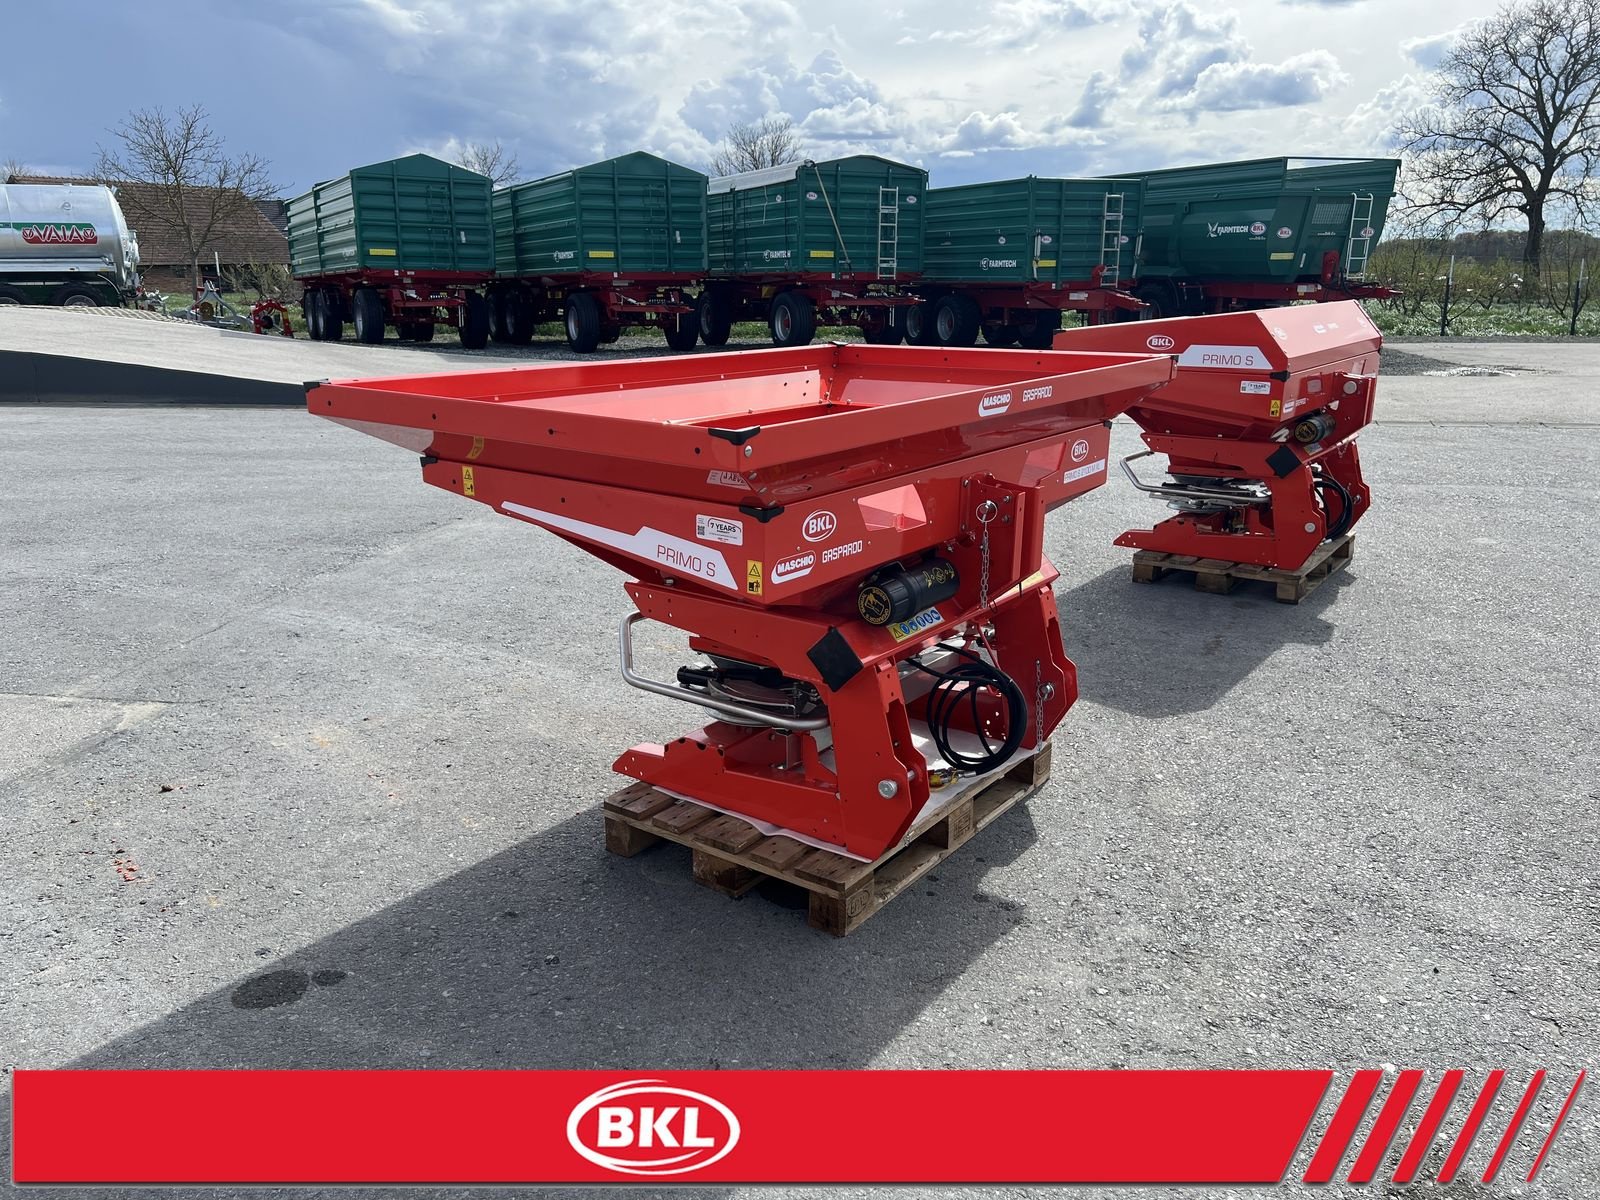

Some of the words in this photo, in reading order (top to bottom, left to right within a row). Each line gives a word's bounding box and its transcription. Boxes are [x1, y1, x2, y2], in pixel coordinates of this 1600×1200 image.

[33, 225, 85, 242] VAIA
[1217, 225, 1249, 236] FARMTECH
[769, 250, 792, 259] FARMTEH
[989, 259, 1017, 268] FARMTECH
[1151, 338, 1171, 346] BKL
[1202, 354, 1242, 366] PRIMO
[1244, 356, 1254, 366] S
[983, 393, 1011, 407] MASCHIO
[1022, 386, 1053, 402] GASPARDO
[1074, 443, 1087, 456] BKL
[715, 523, 737, 533] YEARS
[808, 515, 832, 534] BKL
[657, 544, 702, 573] PRIMO
[706, 561, 716, 577] S
[777, 554, 814, 574] MASCHIO
[822, 540, 863, 563] GASPARDO
